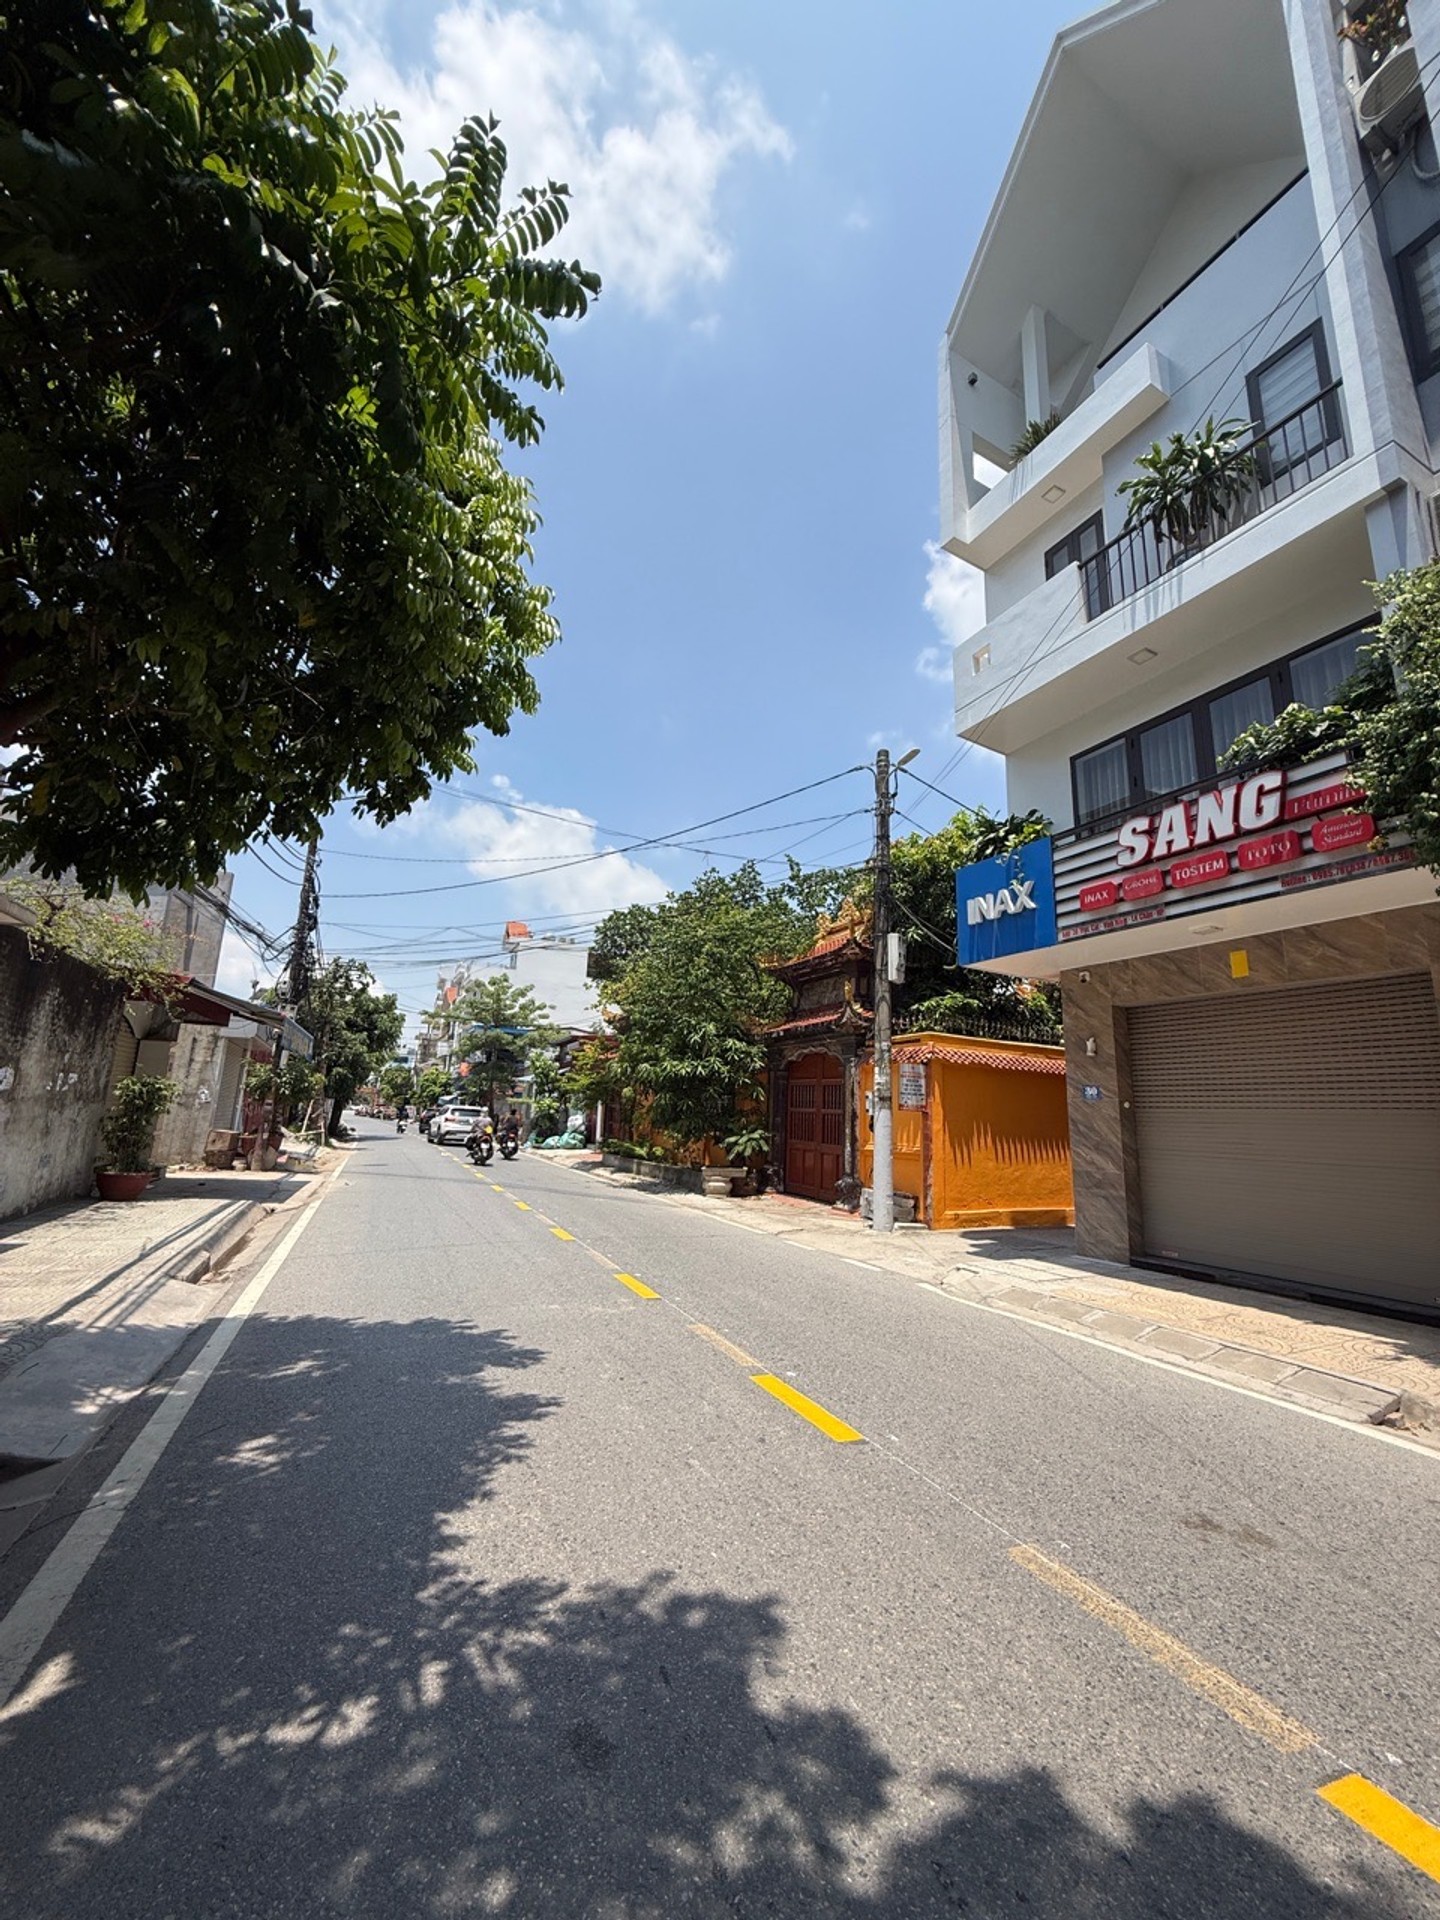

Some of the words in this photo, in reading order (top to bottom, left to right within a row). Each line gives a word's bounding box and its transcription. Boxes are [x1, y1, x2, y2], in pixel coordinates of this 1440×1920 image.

[1116, 770, 1284, 867] SANG
[1246, 839, 1291, 861] TOTO
[1174, 858, 1224, 881] TOSTEM
[966, 880, 1037, 926] INAX
[1084, 889, 1110, 905] INAX
